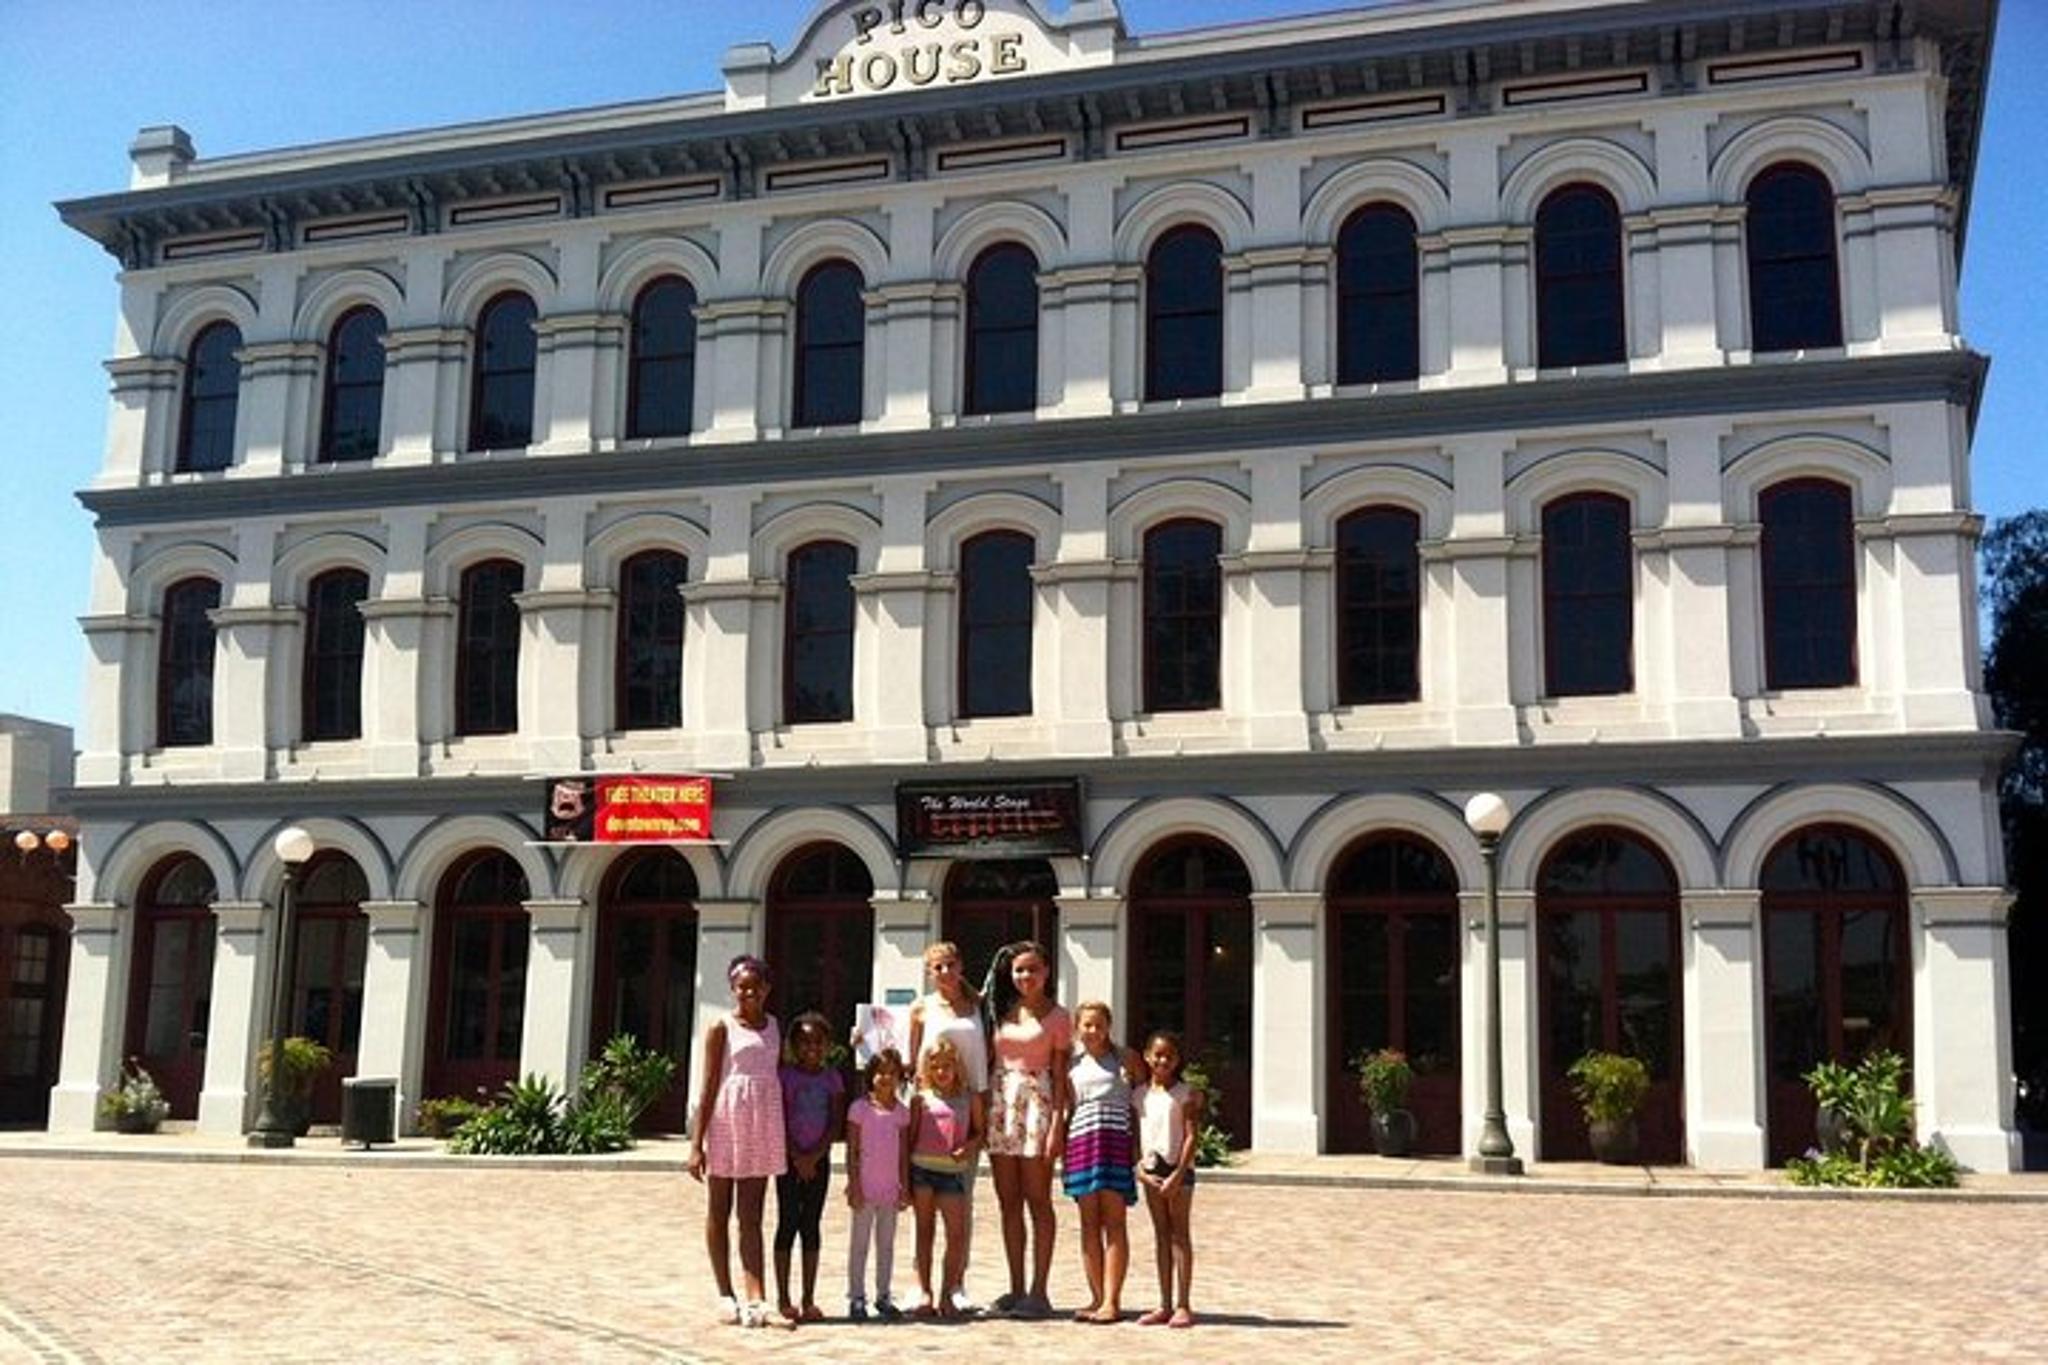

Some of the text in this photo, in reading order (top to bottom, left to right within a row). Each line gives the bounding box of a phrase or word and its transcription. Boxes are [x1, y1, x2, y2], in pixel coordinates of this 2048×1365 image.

[851, 0, 985, 45] PICO
[814, 33, 1027, 97] HOUSE
[921, 796, 943, 811] The
